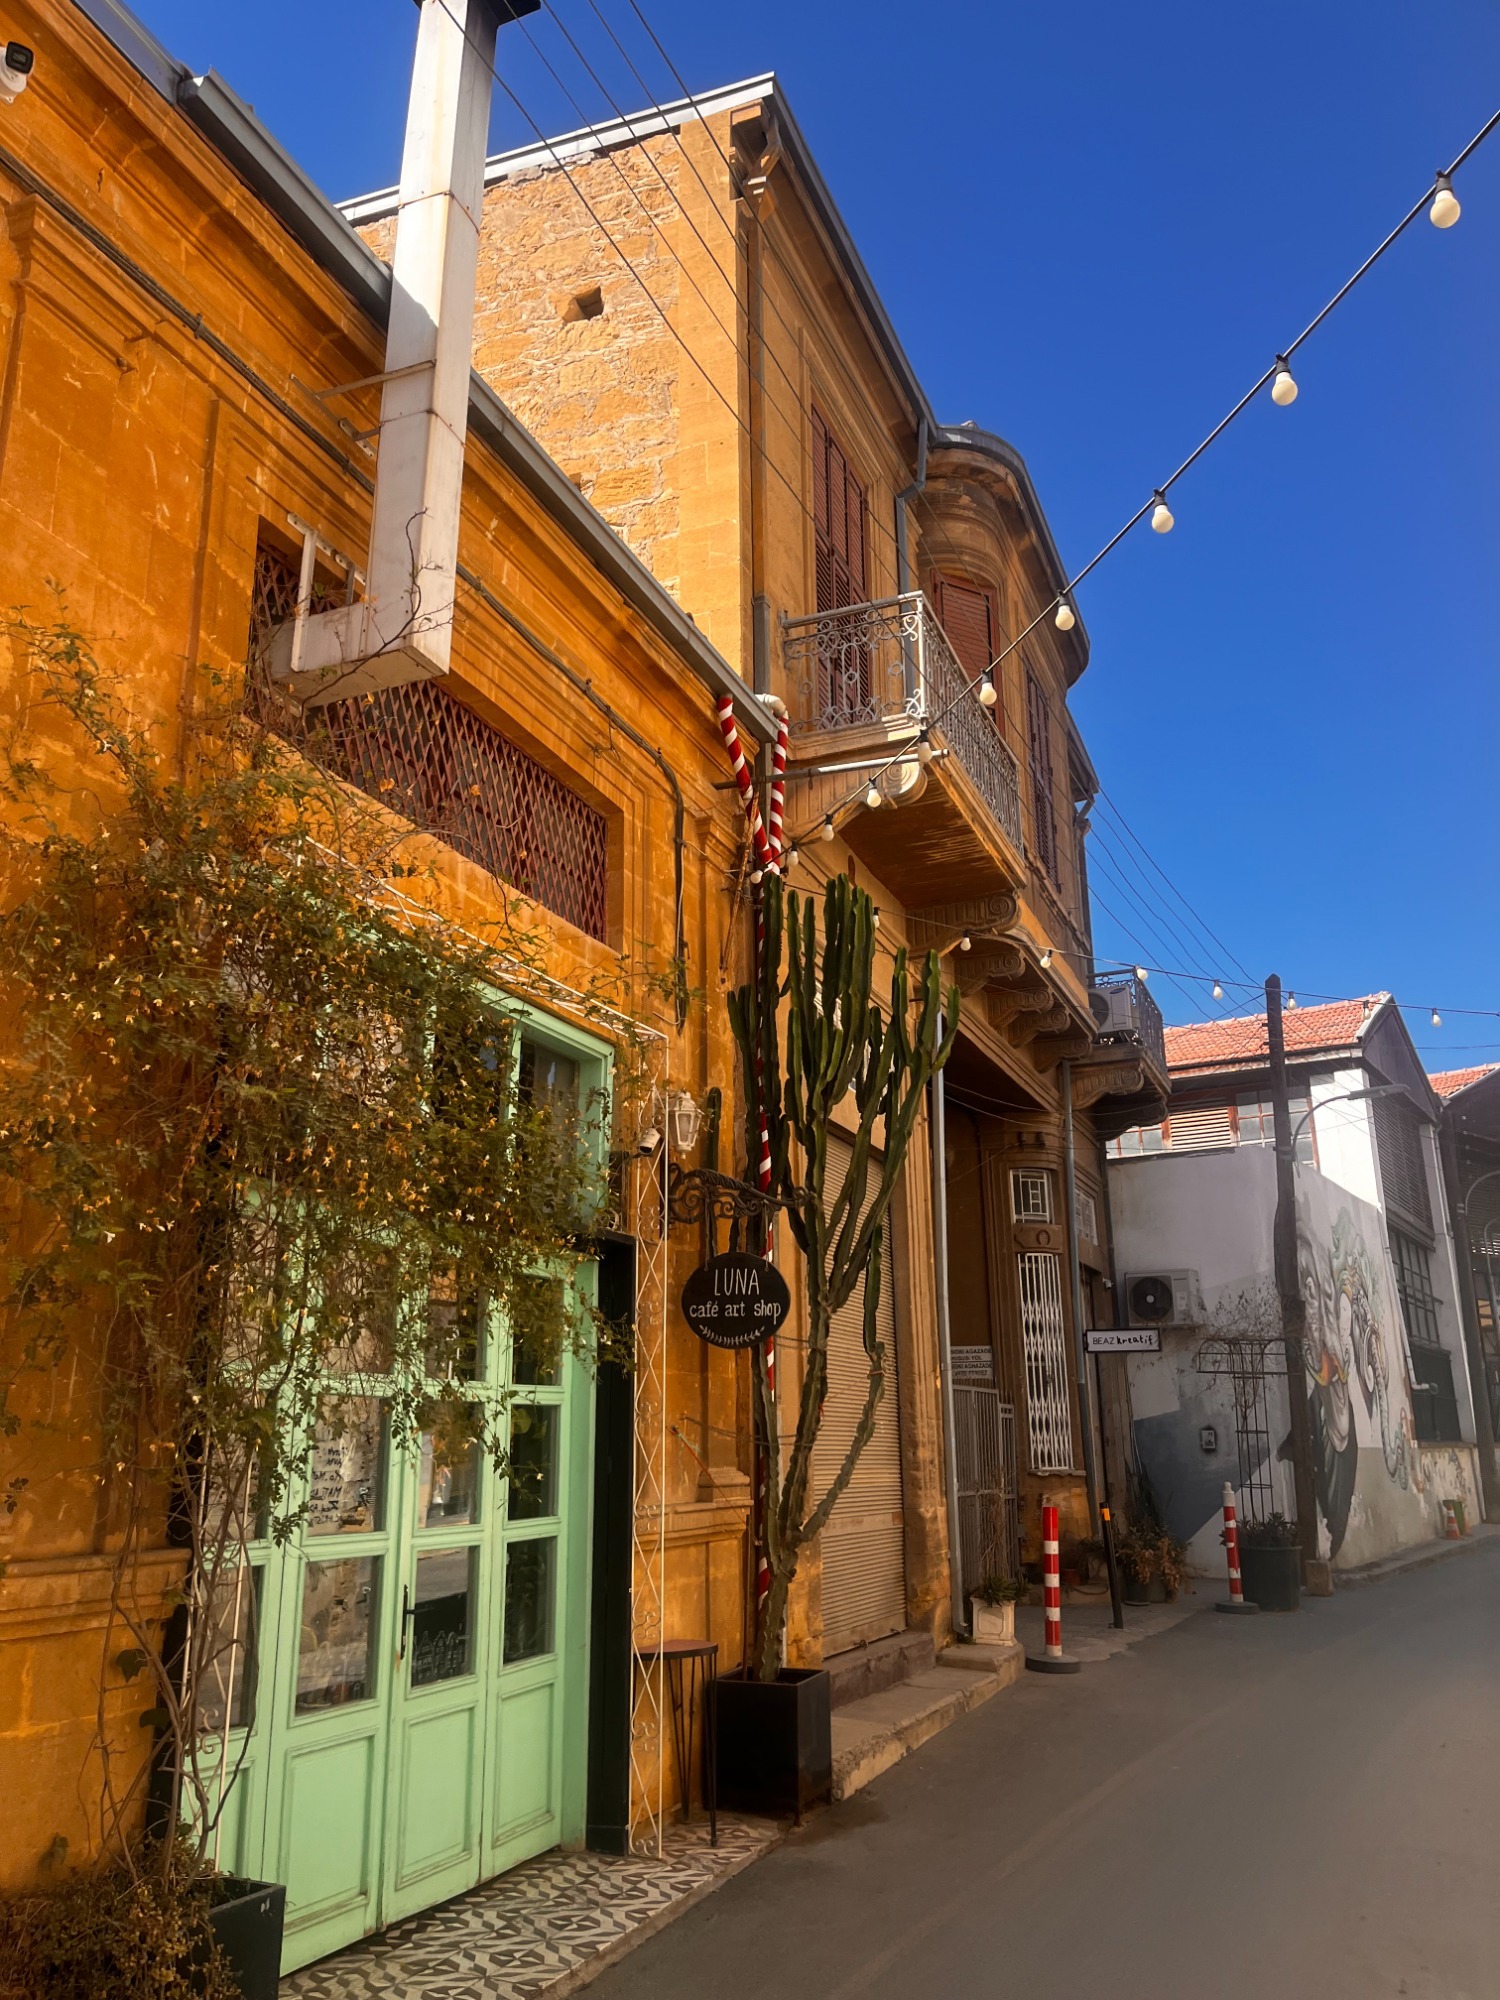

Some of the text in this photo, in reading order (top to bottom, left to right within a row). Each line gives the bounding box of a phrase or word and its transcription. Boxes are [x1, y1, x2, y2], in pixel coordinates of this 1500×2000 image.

[714, 1268, 760, 1296] LUNA
[689, 1299, 782, 1325] café art shop
[1093, 1335, 1153, 1345] BEAZ kreatif
